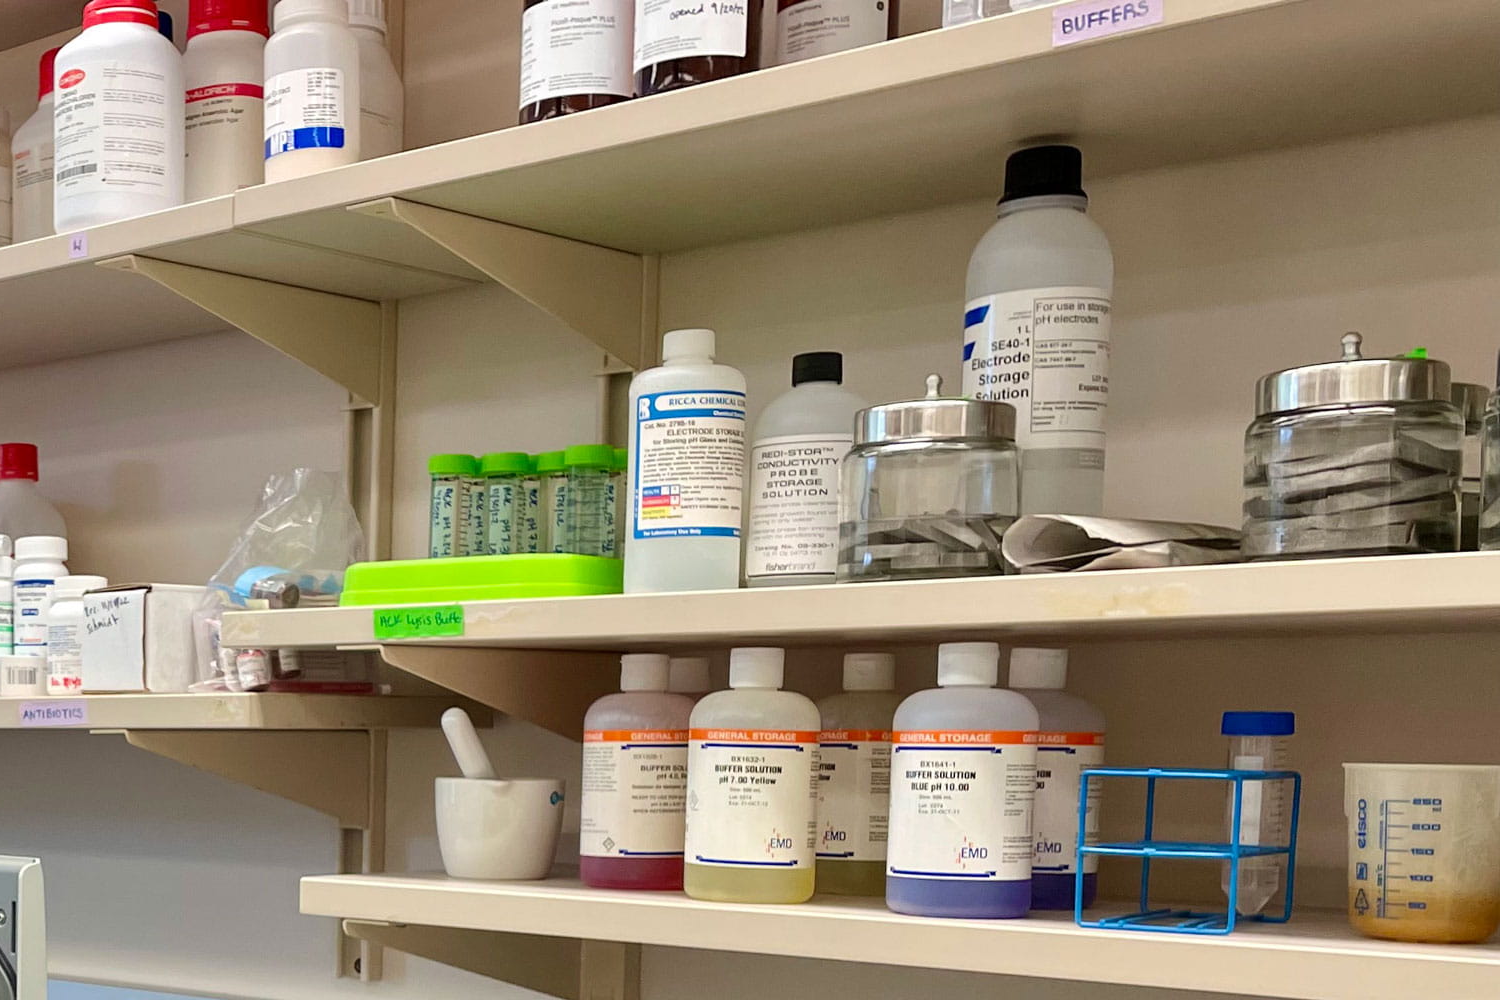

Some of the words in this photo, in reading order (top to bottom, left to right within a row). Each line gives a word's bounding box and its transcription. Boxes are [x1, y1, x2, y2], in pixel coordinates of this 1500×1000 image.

[669, 3, 704, 20] opened
[1062, 0, 1149, 34] BUFFERS
[1036, 302, 1053, 312] For
[1056, 302, 1075, 311] use
[1077, 301, 1086, 310] in
[1036, 315, 1052, 326] pH
[1054, 315, 1099, 325] electrodes
[1018, 326, 1022, 334] 1
[1025, 325, 1031, 333] L
[992, 337, 1031, 353] SE40-1
[971, 352, 1031, 371] Electrode
[978, 370, 1031, 386] Storage
[975, 387, 1030, 400] Solution
[669, 397, 697, 406] RICCA
[700, 397, 736, 406] CHEMICAL
[666, 428, 714, 436] ELECTRODE
[715, 428, 740, 436] STORAGE
[688, 437, 699, 445] pH
[757, 458, 840, 470] CONDUCTIVITY
[770, 468, 819, 478] PROBE
[767, 479, 823, 488] STORAGE
[762, 489, 828, 499] SOLUTION
[501, 519, 511, 532] pH
[526, 517, 537, 531] pH
[765, 562, 816, 572] fisherbrand
[406, 614, 432, 629] Lysis
[23, 707, 83, 720] ANTIBIOTICS
[707, 731, 750, 740] GENERAL
[752, 732, 797, 741] STORAGE
[899, 732, 937, 742] GENERAL
[939, 733, 992, 743] STORAGE
[715, 765, 743, 773] BUFFER
[745, 766, 782, 774] SOLUTION
[719, 777, 729, 785] pH
[750, 776, 776, 785] Yellow
[905, 771, 932, 779] BUFFER
[934, 771, 976, 780] SOLUTION
[911, 782, 929, 791] BLUE
[931, 783, 942, 792] pH
[944, 783, 970, 791] 10.00
[825, 831, 846, 841] EMD
[771, 838, 792, 849] EMD
[1036, 842, 1062, 853] EMD
[961, 847, 988, 859] EMD
